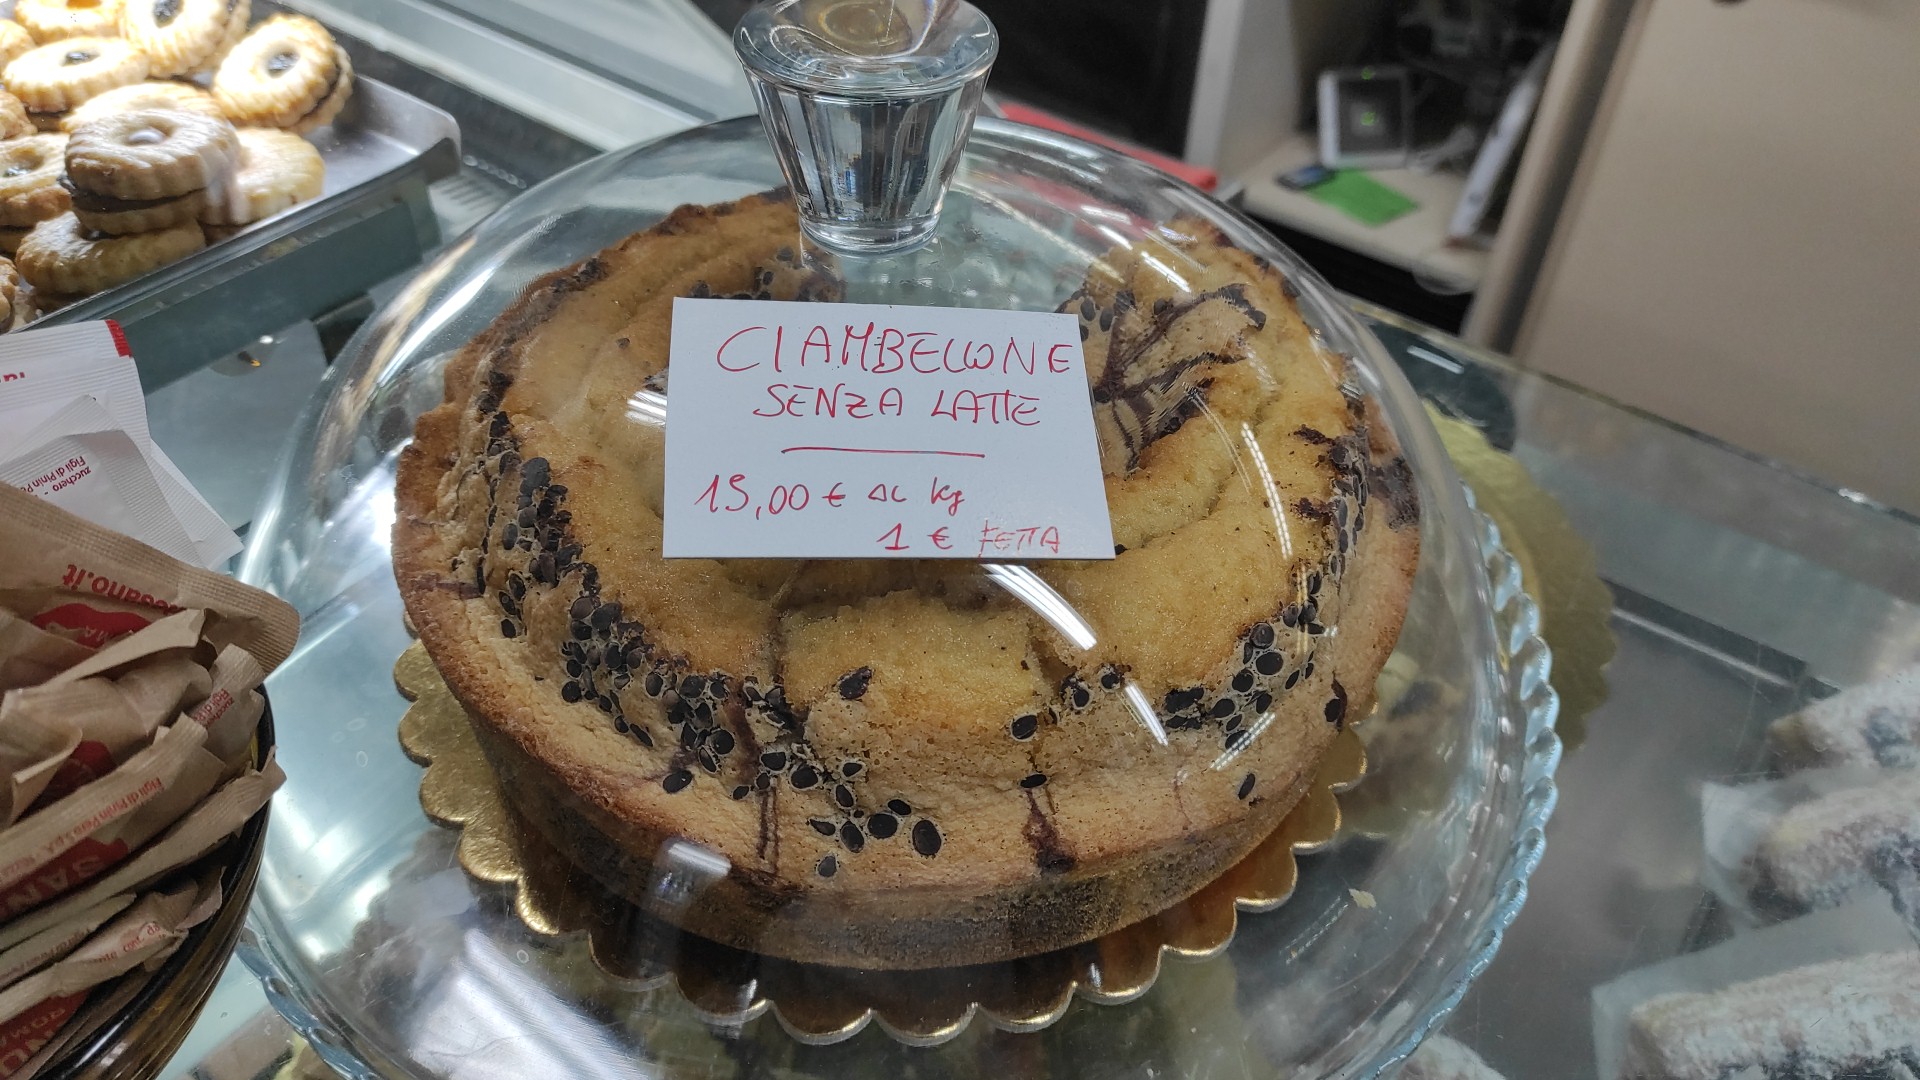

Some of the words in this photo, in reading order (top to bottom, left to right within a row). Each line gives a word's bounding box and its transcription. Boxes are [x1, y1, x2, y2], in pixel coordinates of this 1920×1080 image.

[716, 322, 1073, 376] CIAMBELLONE
[752, 383, 904, 419] SENZA
[930, 388, 1041, 426] LATTE
[55, 467, 65, 478] di
[65, 456, 86, 472] Figli
[32, 471, 57, 488] Pinin
[52, 466, 91, 492] zucchero
[822, 482, 846, 508] €
[876, 522, 909, 551] 1
[927, 526, 953, 550] €
